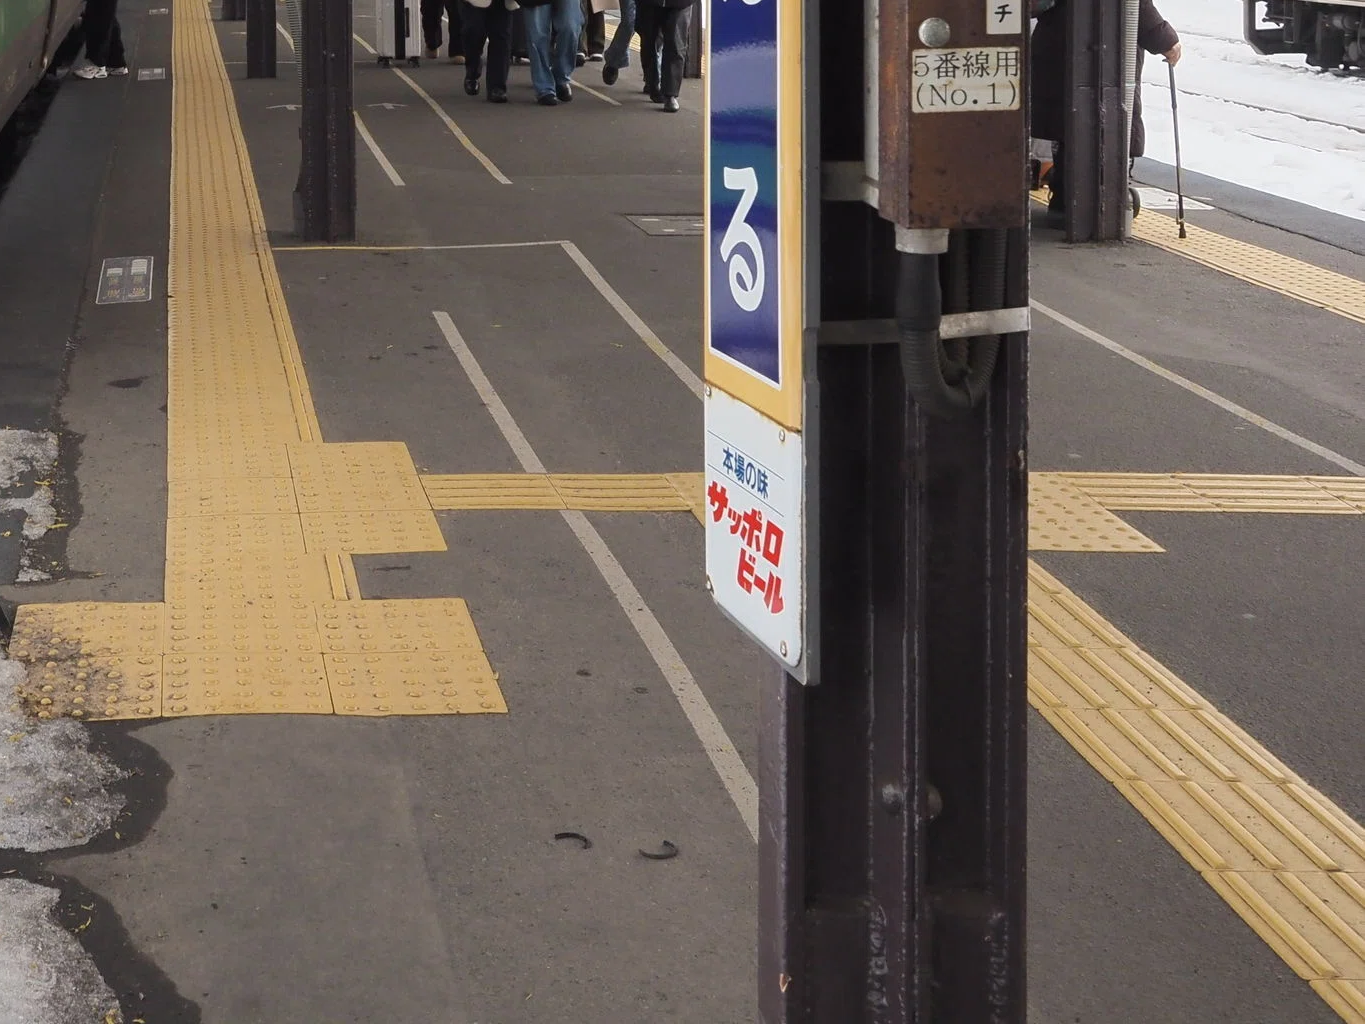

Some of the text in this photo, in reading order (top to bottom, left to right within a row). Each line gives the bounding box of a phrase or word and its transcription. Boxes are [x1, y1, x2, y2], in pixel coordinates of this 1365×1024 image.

[913, 51, 1020, 79] 5番線用
[915, 80, 1018, 109] (No.1)
[722, 447, 769, 499] 本場の味
[708, 480, 784, 568] サッポロ
[736, 547, 785, 614] ビール
